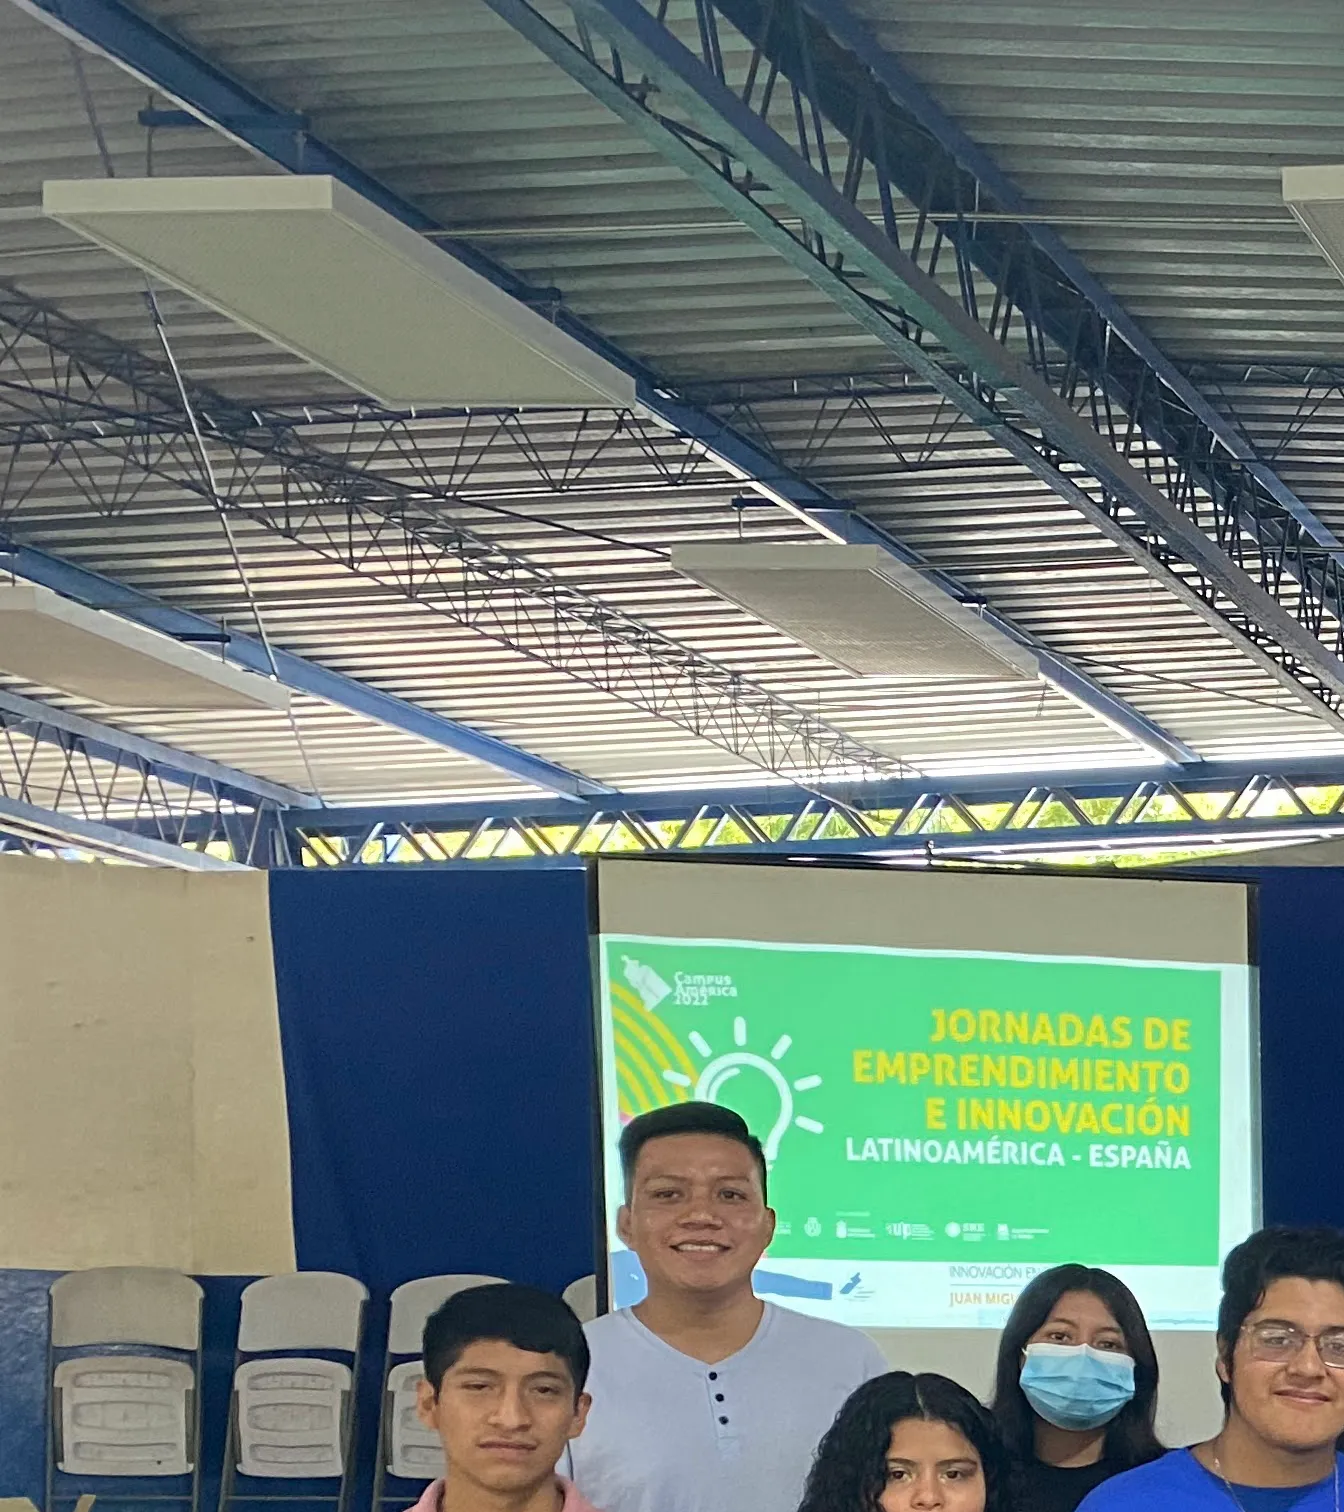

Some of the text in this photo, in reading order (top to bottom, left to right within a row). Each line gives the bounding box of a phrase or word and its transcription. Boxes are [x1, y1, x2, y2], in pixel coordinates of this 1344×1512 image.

[929, 1008, 1192, 1051] JORNADAS DE
[853, 1050, 1191, 1094] EMPRENDIMIENTO
[926, 1097, 1191, 1137] E INNOVACIÓN
[846, 1135, 1066, 1167] LATINOAMÉRICA
[1089, 1140, 1192, 1170] ESPAÑA
[948, 1292, 982, 1307] JUAN
